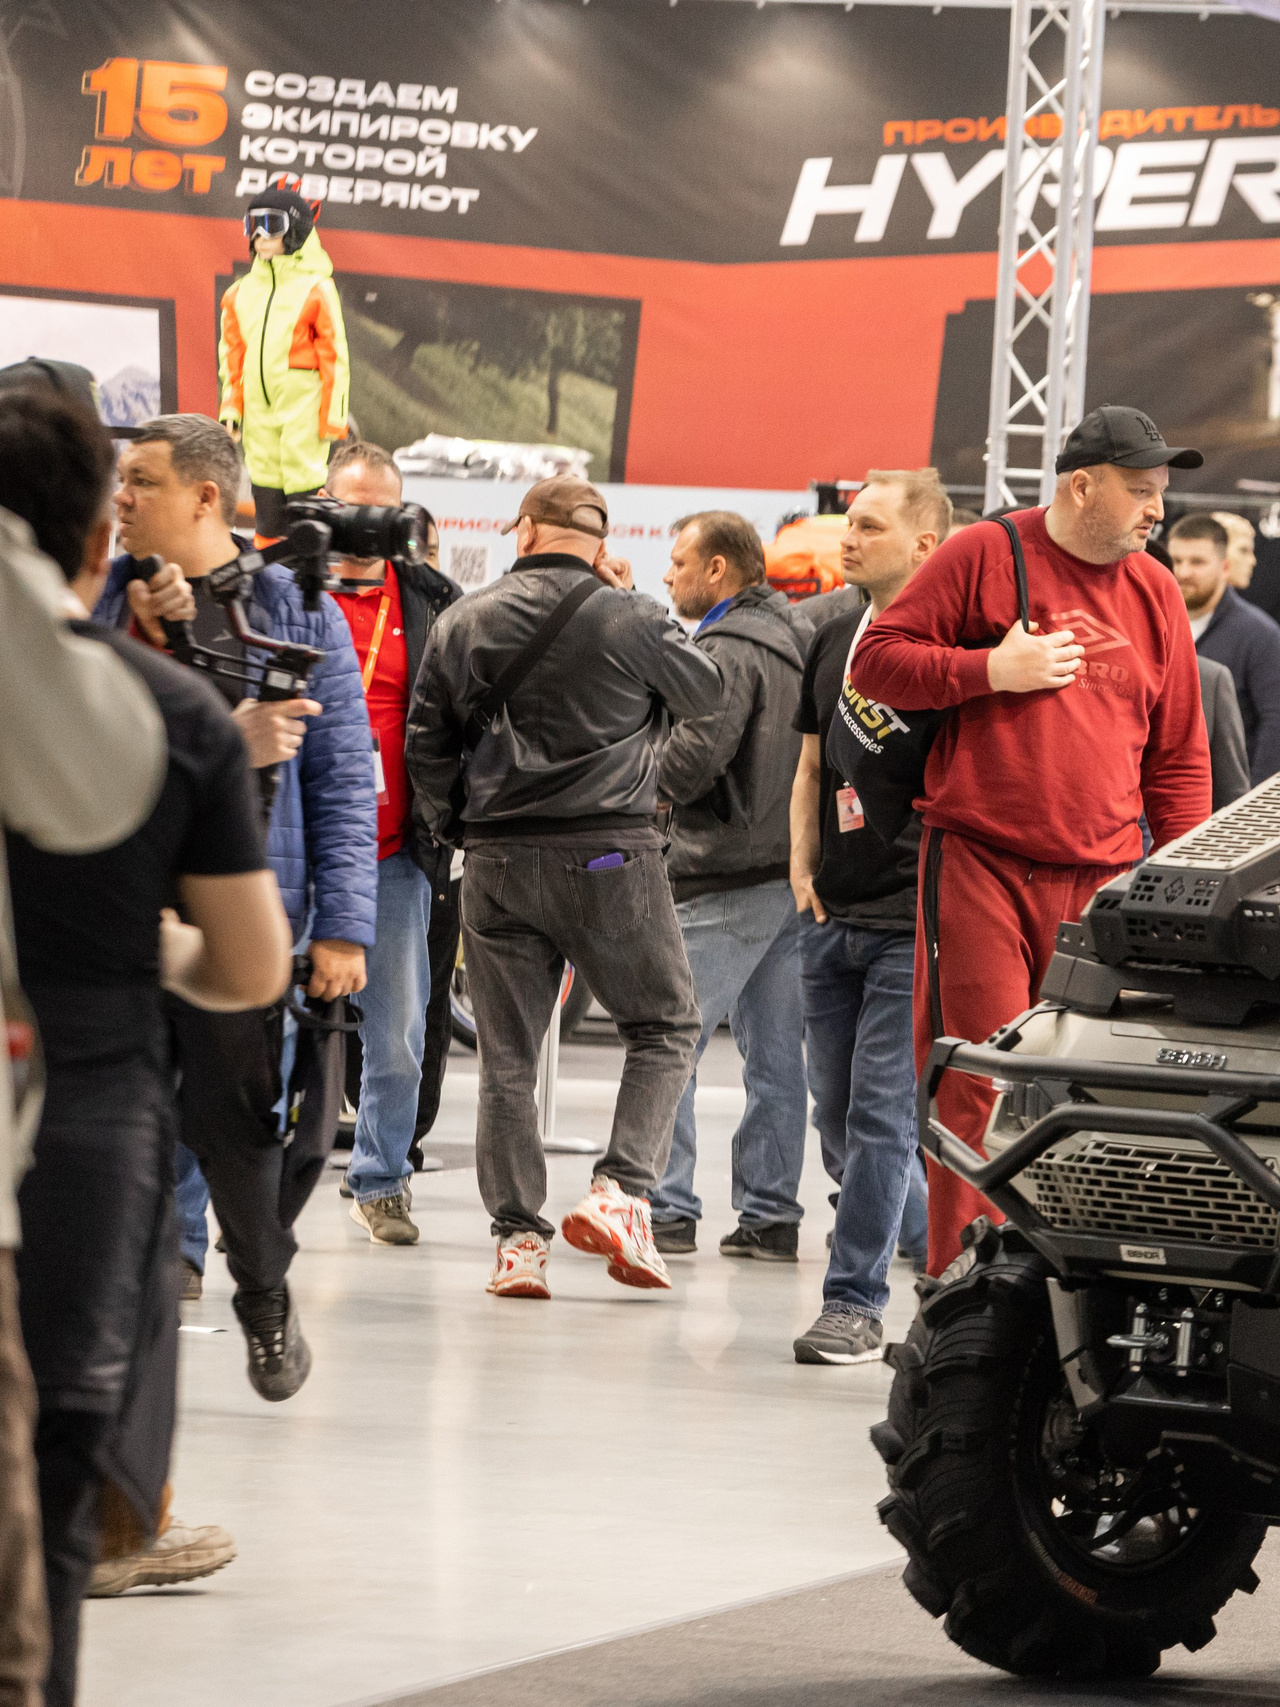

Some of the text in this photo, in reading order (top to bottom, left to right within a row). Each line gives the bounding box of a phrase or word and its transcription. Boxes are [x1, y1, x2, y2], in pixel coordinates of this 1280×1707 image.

[81, 57, 229, 146] 15
[244, 70, 459, 114] СОЗДАЕМ
[240, 102, 539, 153] ЭКИПИРОВКУ
[239, 135, 448, 179] КОТОРОЙ
[843, 708, 885, 754] accessories
